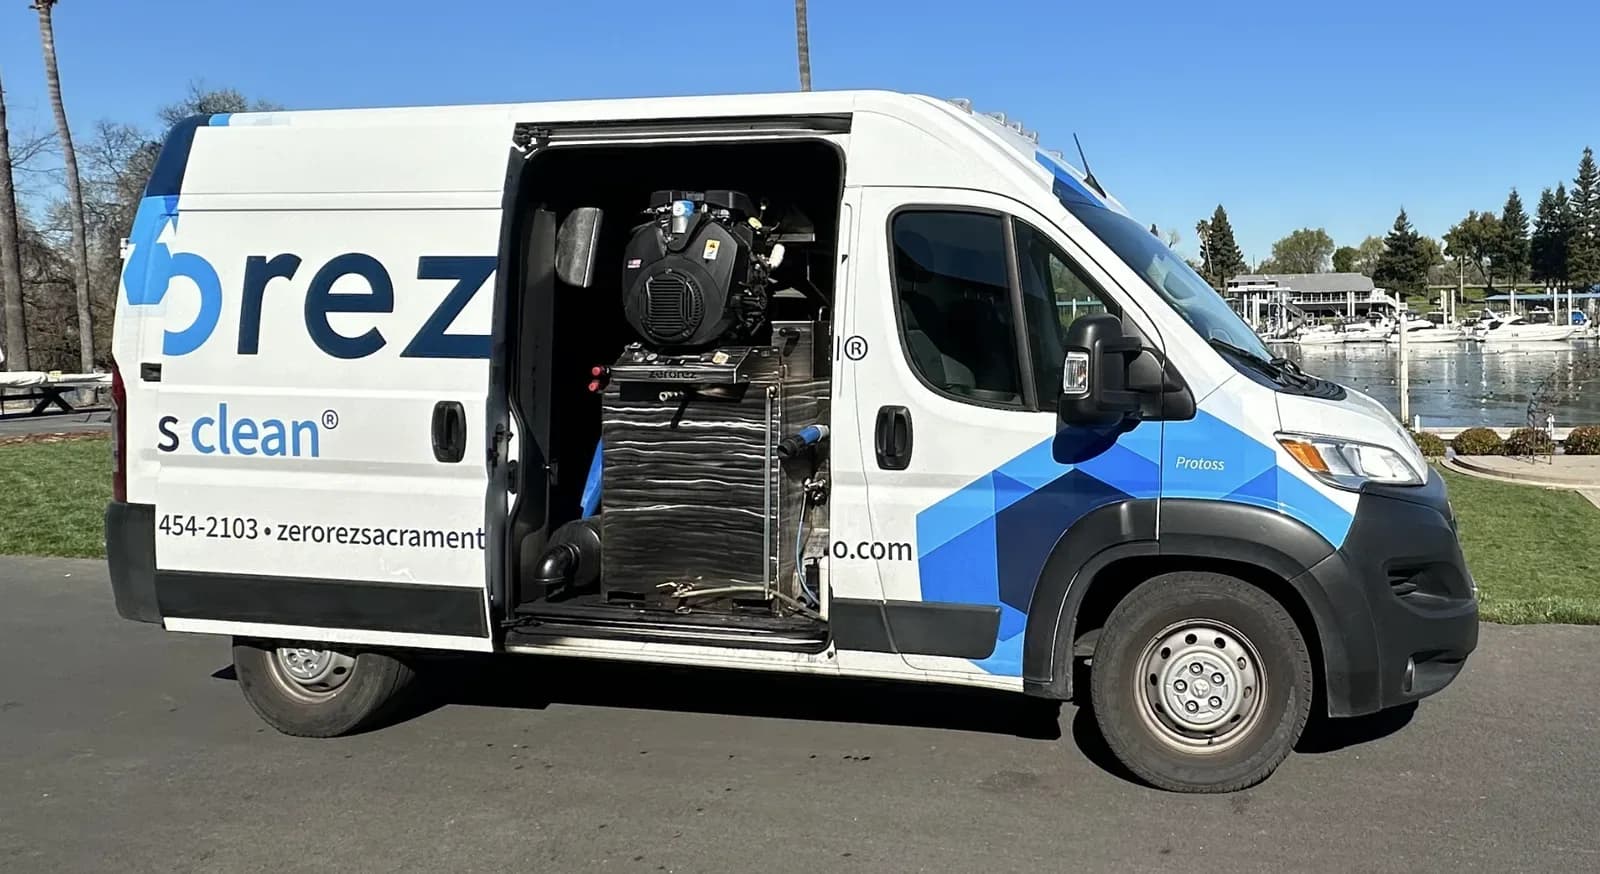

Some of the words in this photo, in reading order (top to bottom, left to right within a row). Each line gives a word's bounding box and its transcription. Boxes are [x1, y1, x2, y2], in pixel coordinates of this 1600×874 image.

[157, 415, 180, 453] s
[1175, 456, 1225, 471] Protoss
[158, 514, 258, 540] 454-2103
[276, 523, 487, 550] zerorezsacrament
[832, 540, 912, 561] o.com
